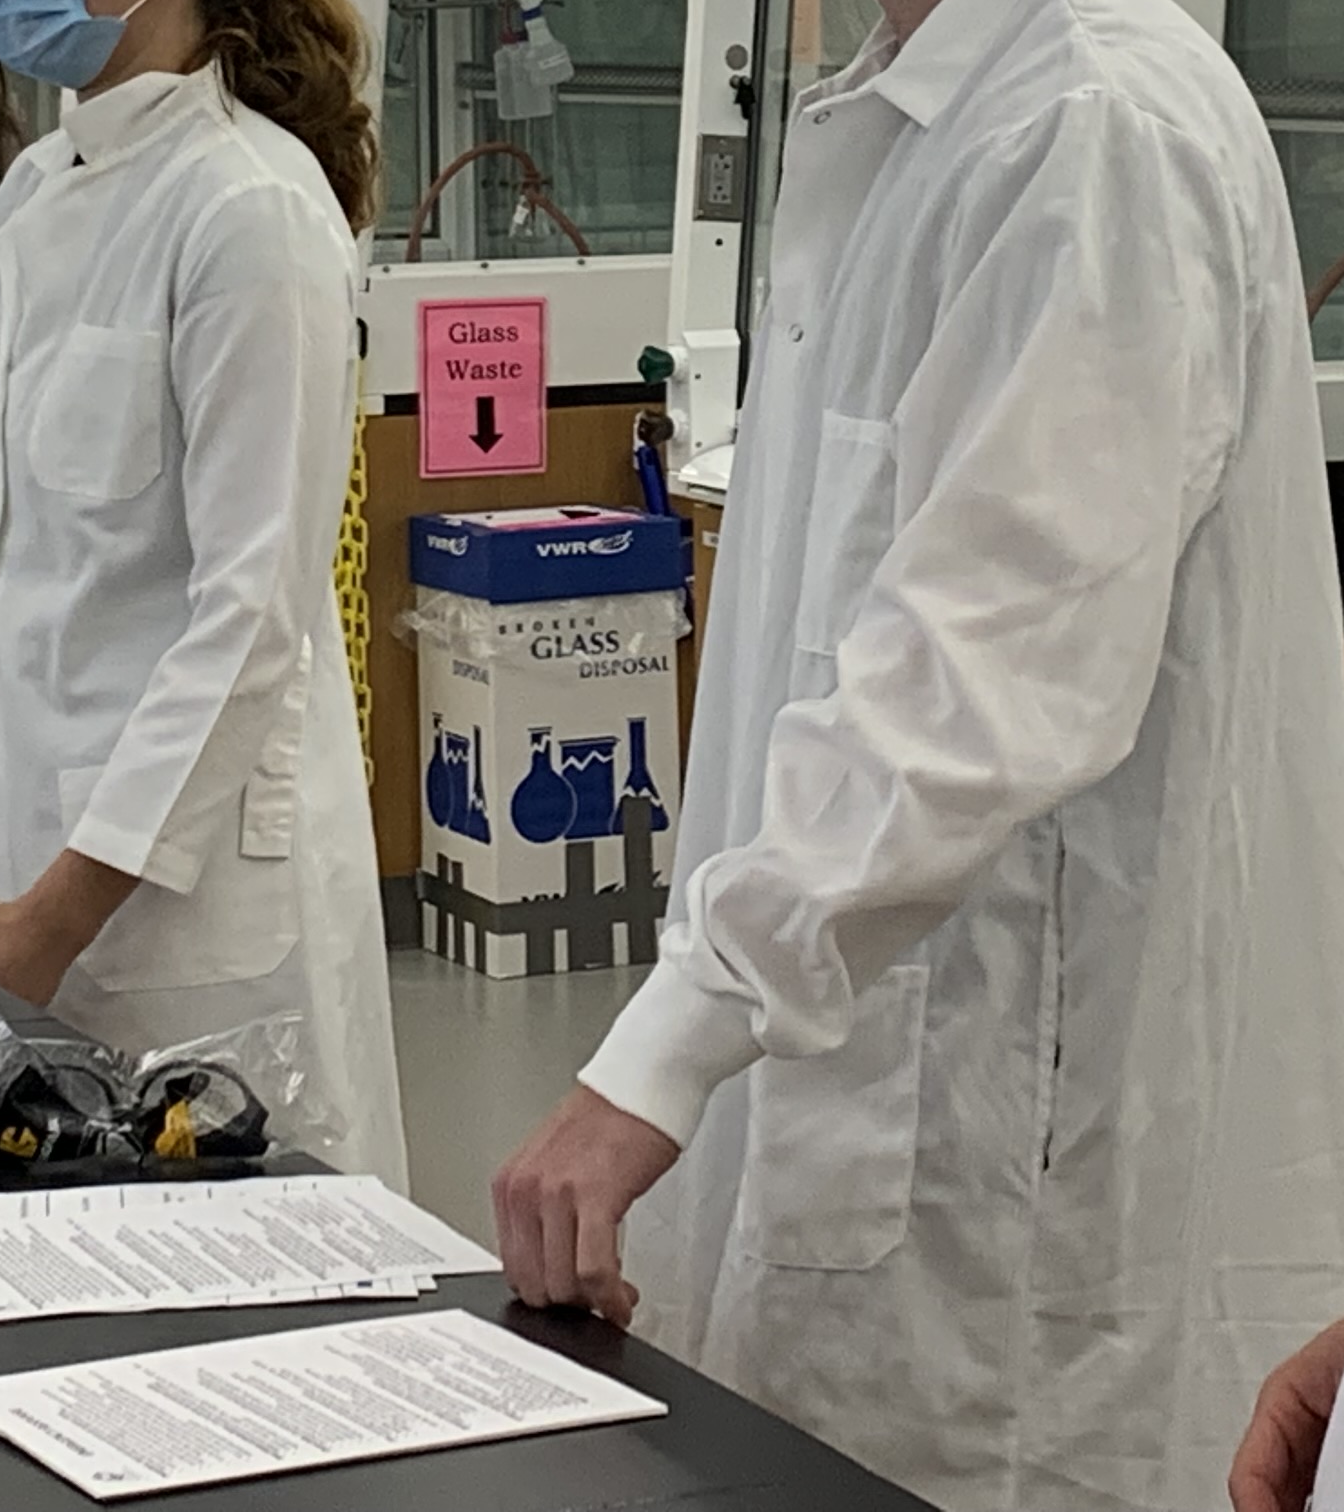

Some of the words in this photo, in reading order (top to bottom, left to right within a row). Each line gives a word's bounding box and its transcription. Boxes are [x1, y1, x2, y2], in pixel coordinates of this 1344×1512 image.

[448, 321, 520, 345] Glass
[445, 359, 523, 381] Waste
[536, 539, 589, 558] VWR
[497, 616, 597, 636] BROKEN
[529, 629, 621, 661] GLASS
[577, 655, 672, 680] DISPOSAL
